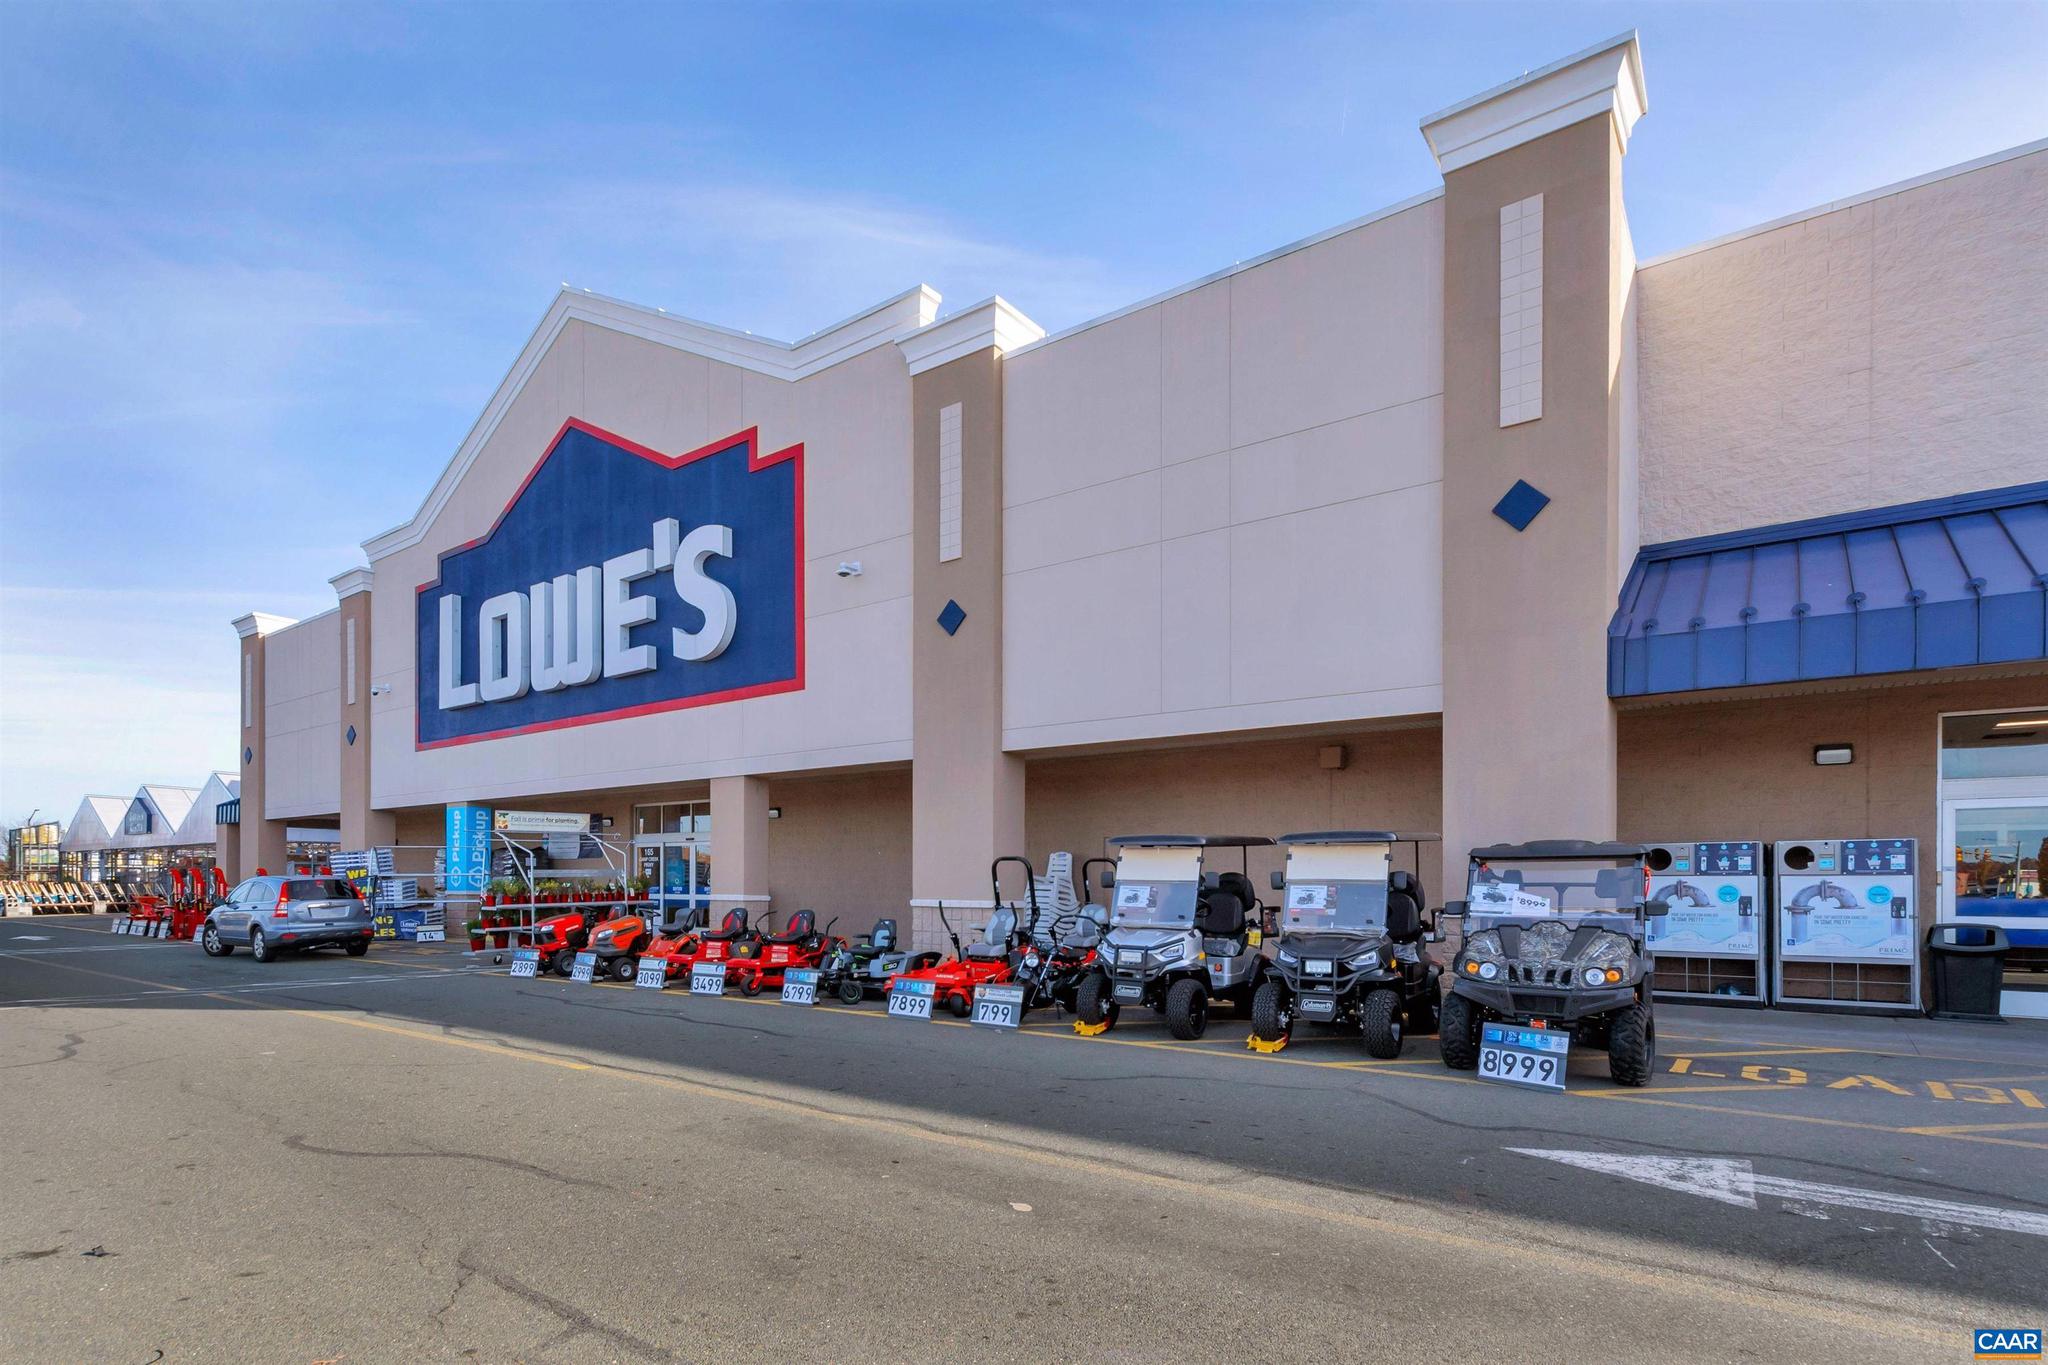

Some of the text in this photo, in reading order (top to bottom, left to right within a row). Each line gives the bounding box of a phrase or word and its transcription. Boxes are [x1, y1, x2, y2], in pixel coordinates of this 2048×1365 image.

[438, 516, 737, 710] LOWE'S
[527, 817, 545, 825] prime
[452, 810, 462, 862] Pickup
[471, 811, 489, 862] Pickup
[1517, 896, 1546, 908] $8999
[512, 962, 535, 974] 2899
[573, 966, 592, 980] 2999
[638, 972, 661, 986] 3099
[693, 977, 722, 992] 3499
[784, 985, 812, 1001] 6799
[891, 995, 926, 1015] 7899
[980, 1004, 1010, 1023] 799
